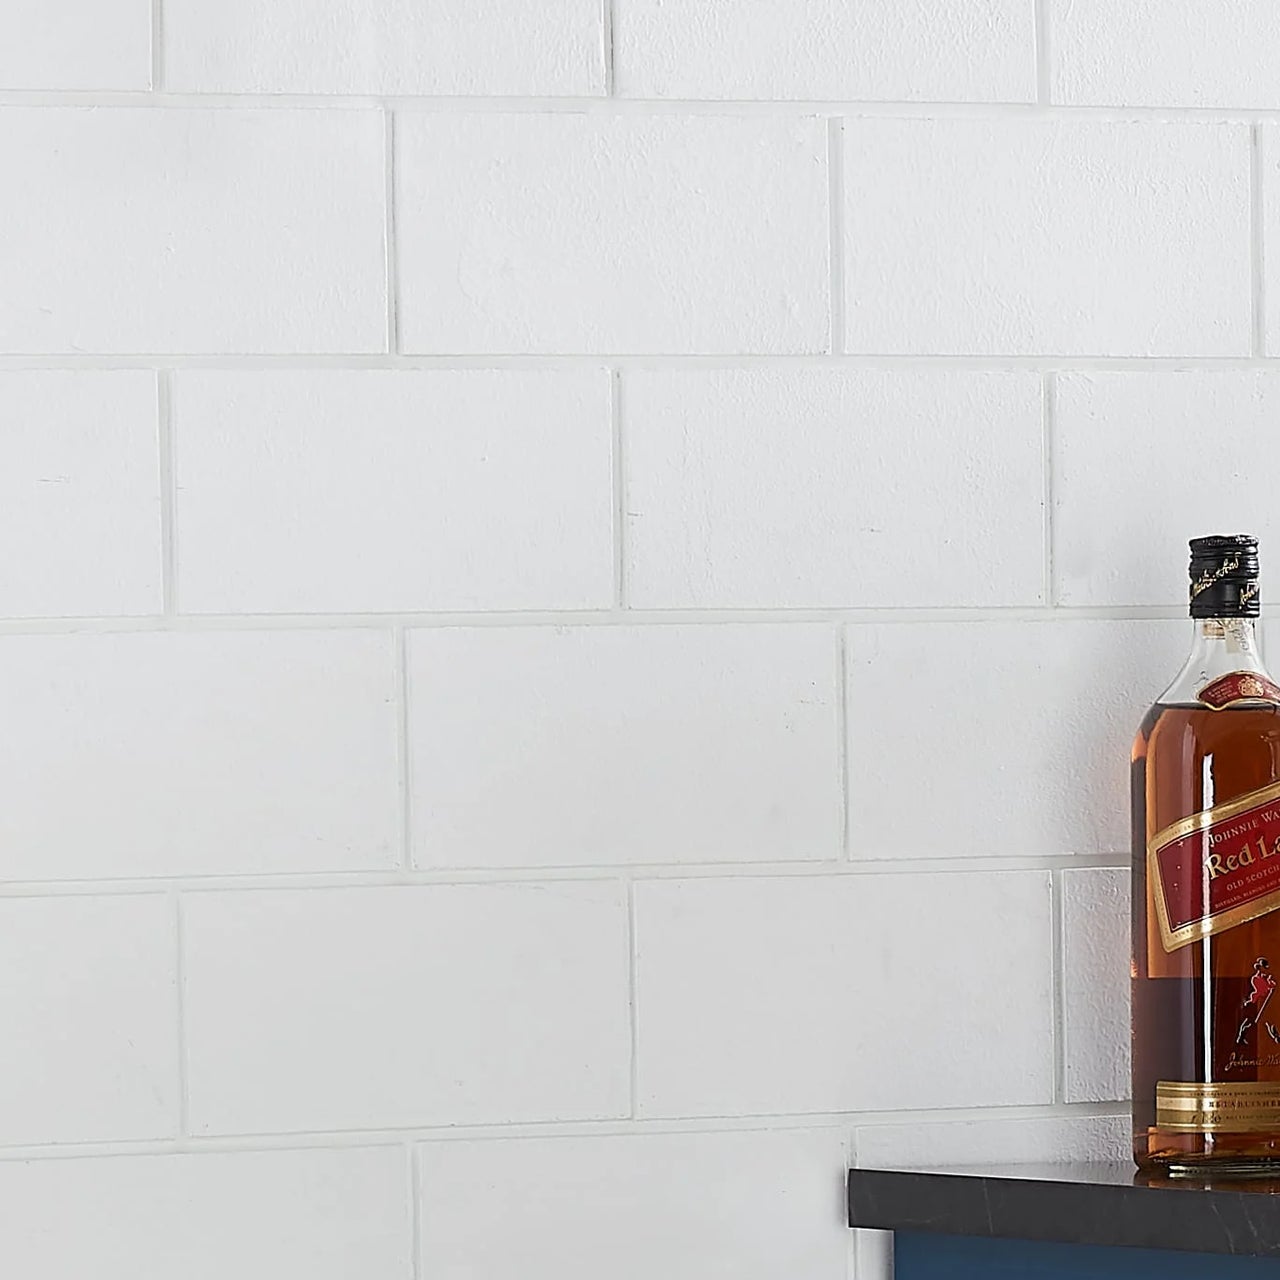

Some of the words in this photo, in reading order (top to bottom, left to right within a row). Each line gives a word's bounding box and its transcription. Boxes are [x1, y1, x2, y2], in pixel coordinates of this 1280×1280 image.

[1209, 819, 1258, 848] JOHNNIE
[1204, 842, 1257, 881] Red
[1226, 879, 1245, 891] OLD
[1245, 864, 1280, 884] SCOTCH
[1224, 1051, 1264, 1072] Johnnie
